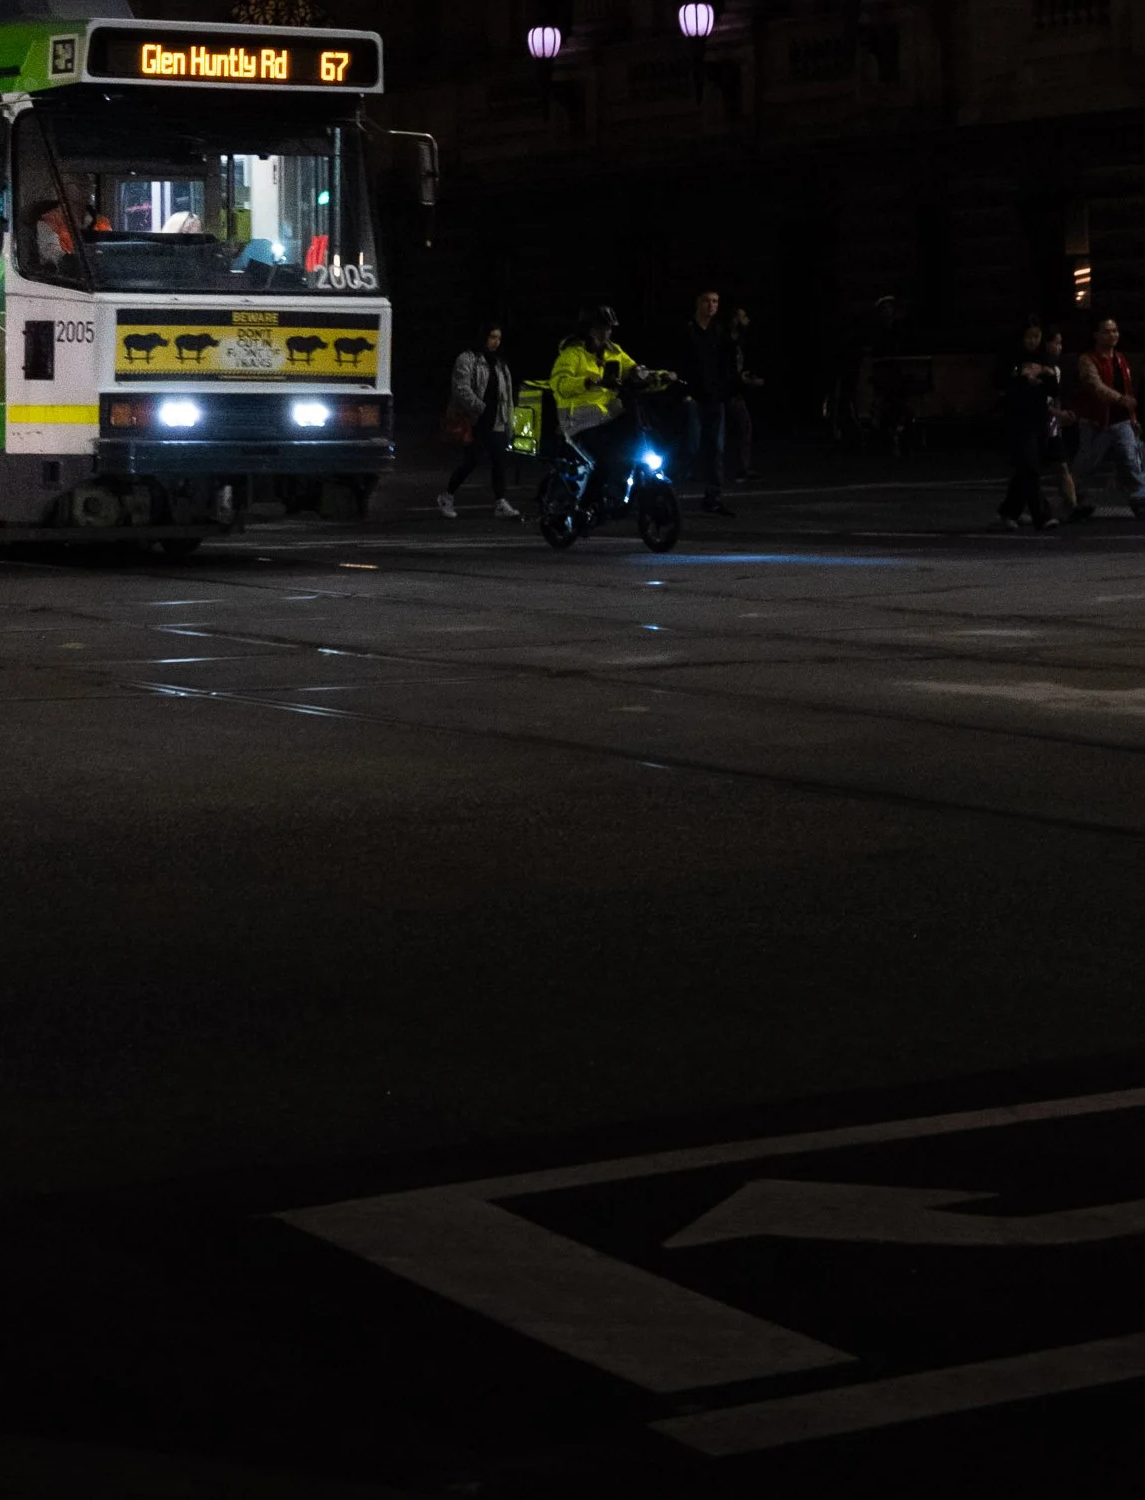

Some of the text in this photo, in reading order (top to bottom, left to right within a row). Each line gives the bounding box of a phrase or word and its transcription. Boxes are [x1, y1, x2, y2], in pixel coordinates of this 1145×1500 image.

[141, 43, 350, 82] Glen Huntly Rd 67
[313, 263, 378, 290] 2005
[232, 311, 279, 323] BEWARE
[56, 320, 94, 343] 2005
[237, 328, 273, 338] DON'T
[237, 338, 273, 348] CUT IN
